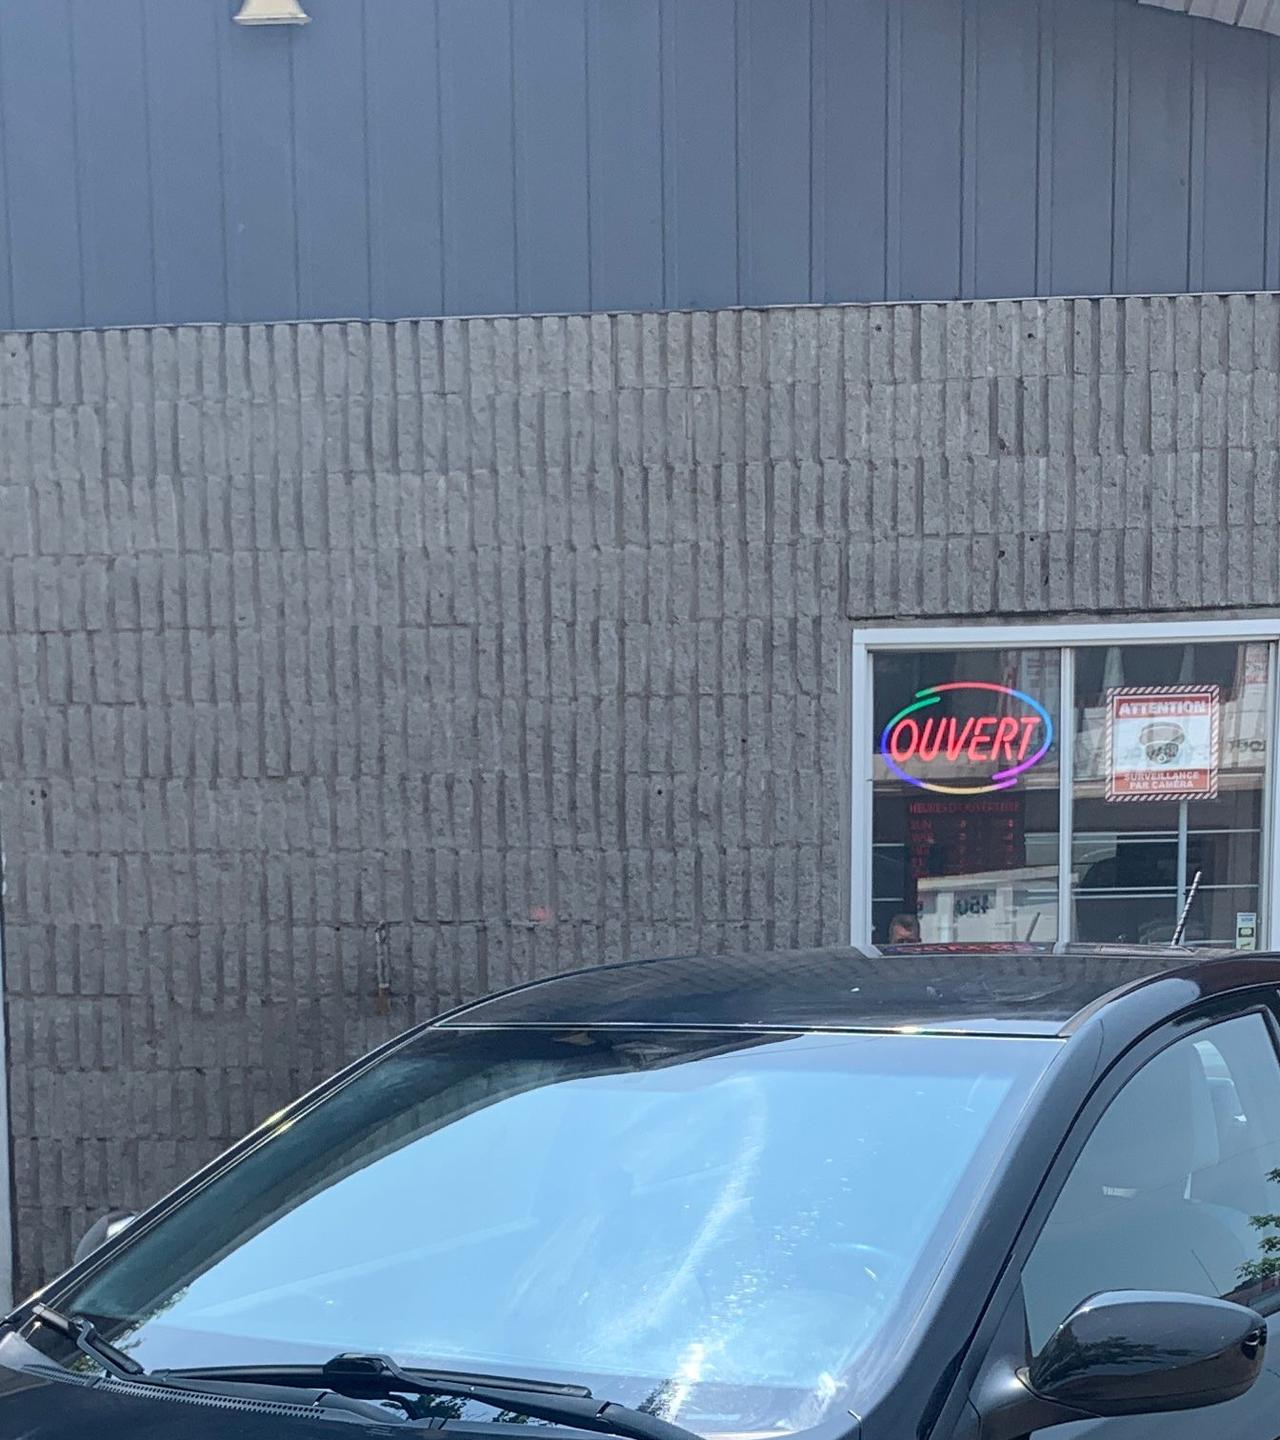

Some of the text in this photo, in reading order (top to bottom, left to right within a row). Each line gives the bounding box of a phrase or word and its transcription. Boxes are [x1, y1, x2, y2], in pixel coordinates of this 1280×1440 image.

[1118, 700, 1207, 716] ATTENTION
[890, 716, 1042, 762] OUVERT
[1124, 771, 1200, 782] SURVEILLANCE
[1129, 781, 1150, 790] PAR
